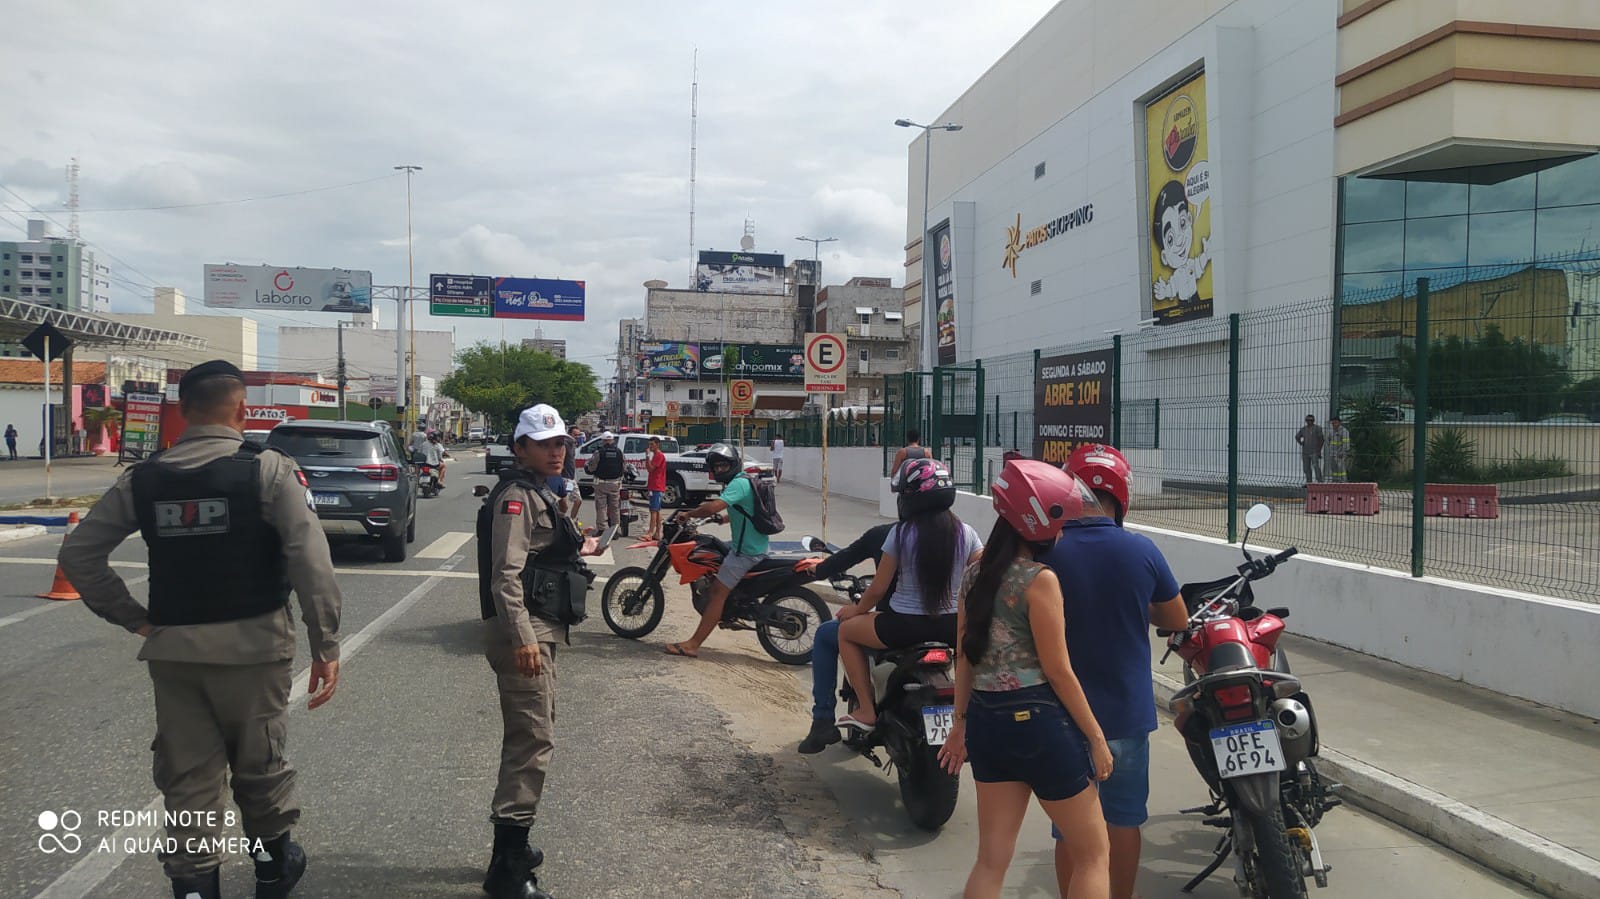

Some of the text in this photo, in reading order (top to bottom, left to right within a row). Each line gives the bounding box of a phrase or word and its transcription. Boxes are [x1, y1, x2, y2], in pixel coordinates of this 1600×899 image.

[1187, 174, 1200, 187] AQUI
[1187, 181, 1209, 197] ALEGRIA
[819, 343, 833, 364] E
[1041, 359, 1106, 379] SEGUNDA A SÁBADO
[1044, 380, 1101, 406] ABRE 10H
[253, 408, 287, 420] PATOS
[1039, 424, 1104, 438] DOMINGO E FERIADO
[1043, 440, 1072, 463] ABRE
[1230, 726, 1255, 736] BRASIL
[1225, 749, 1275, 772] 6F94
